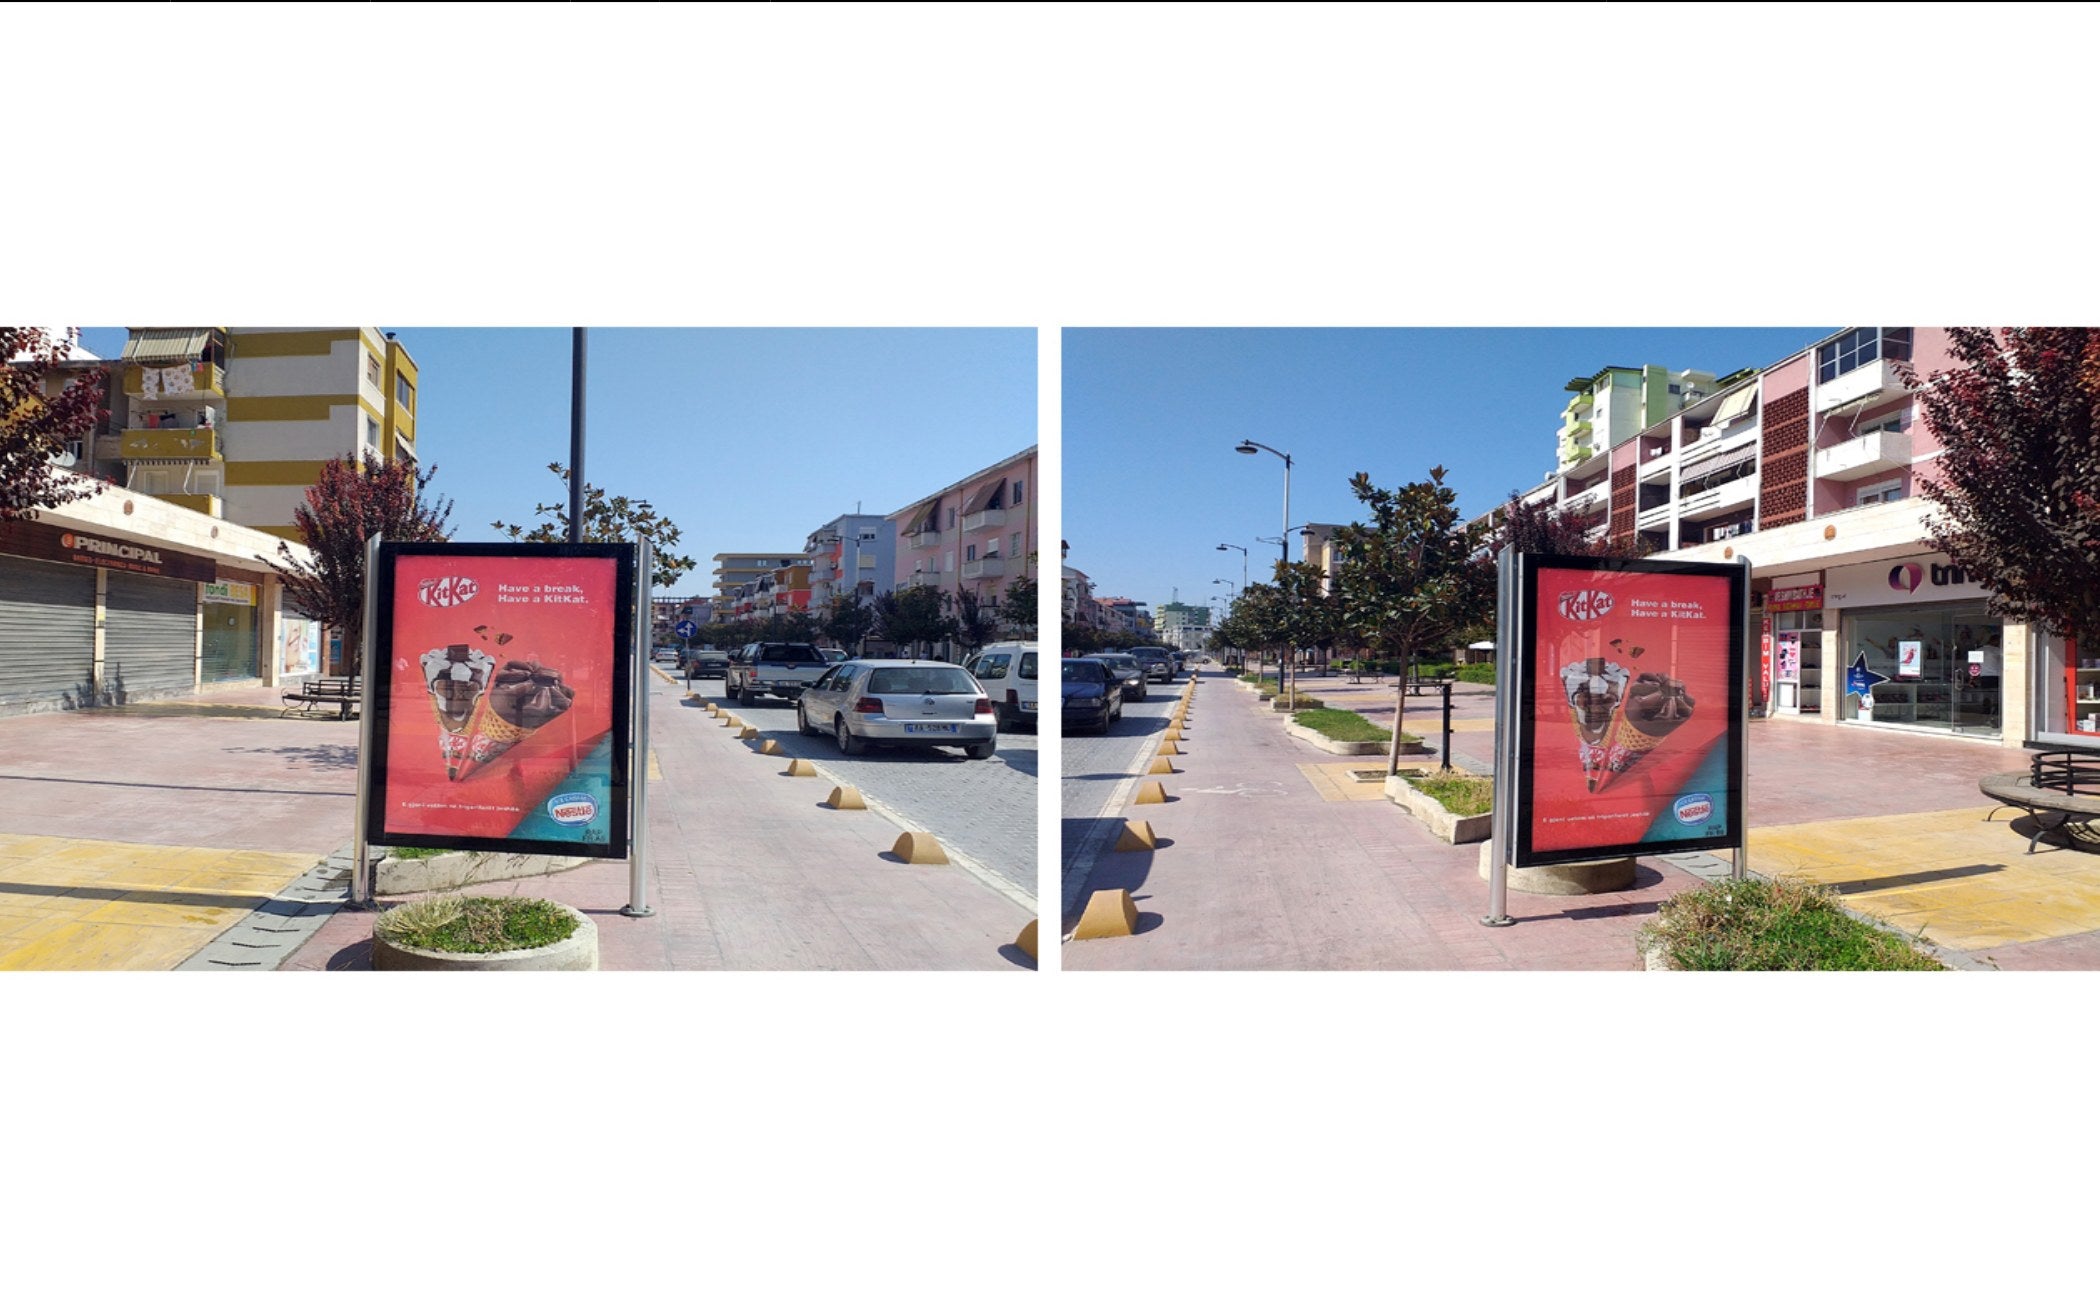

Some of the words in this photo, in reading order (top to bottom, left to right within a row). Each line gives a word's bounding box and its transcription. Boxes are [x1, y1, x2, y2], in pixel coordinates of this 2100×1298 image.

[74, 536, 163, 564] PRINCIPAL
[425, 576, 477, 607] KitKat
[498, 584, 530, 593] Have
[533, 585, 541, 593] a
[544, 584, 584, 595] break,
[498, 594, 530, 603] Have
[544, 595, 589, 604] KitKat.
[1631, 599, 1658, 608] Have
[1671, 600, 1703, 610] break,
[1566, 590, 1613, 620] KitKat
[1631, 609, 1658, 618] Have
